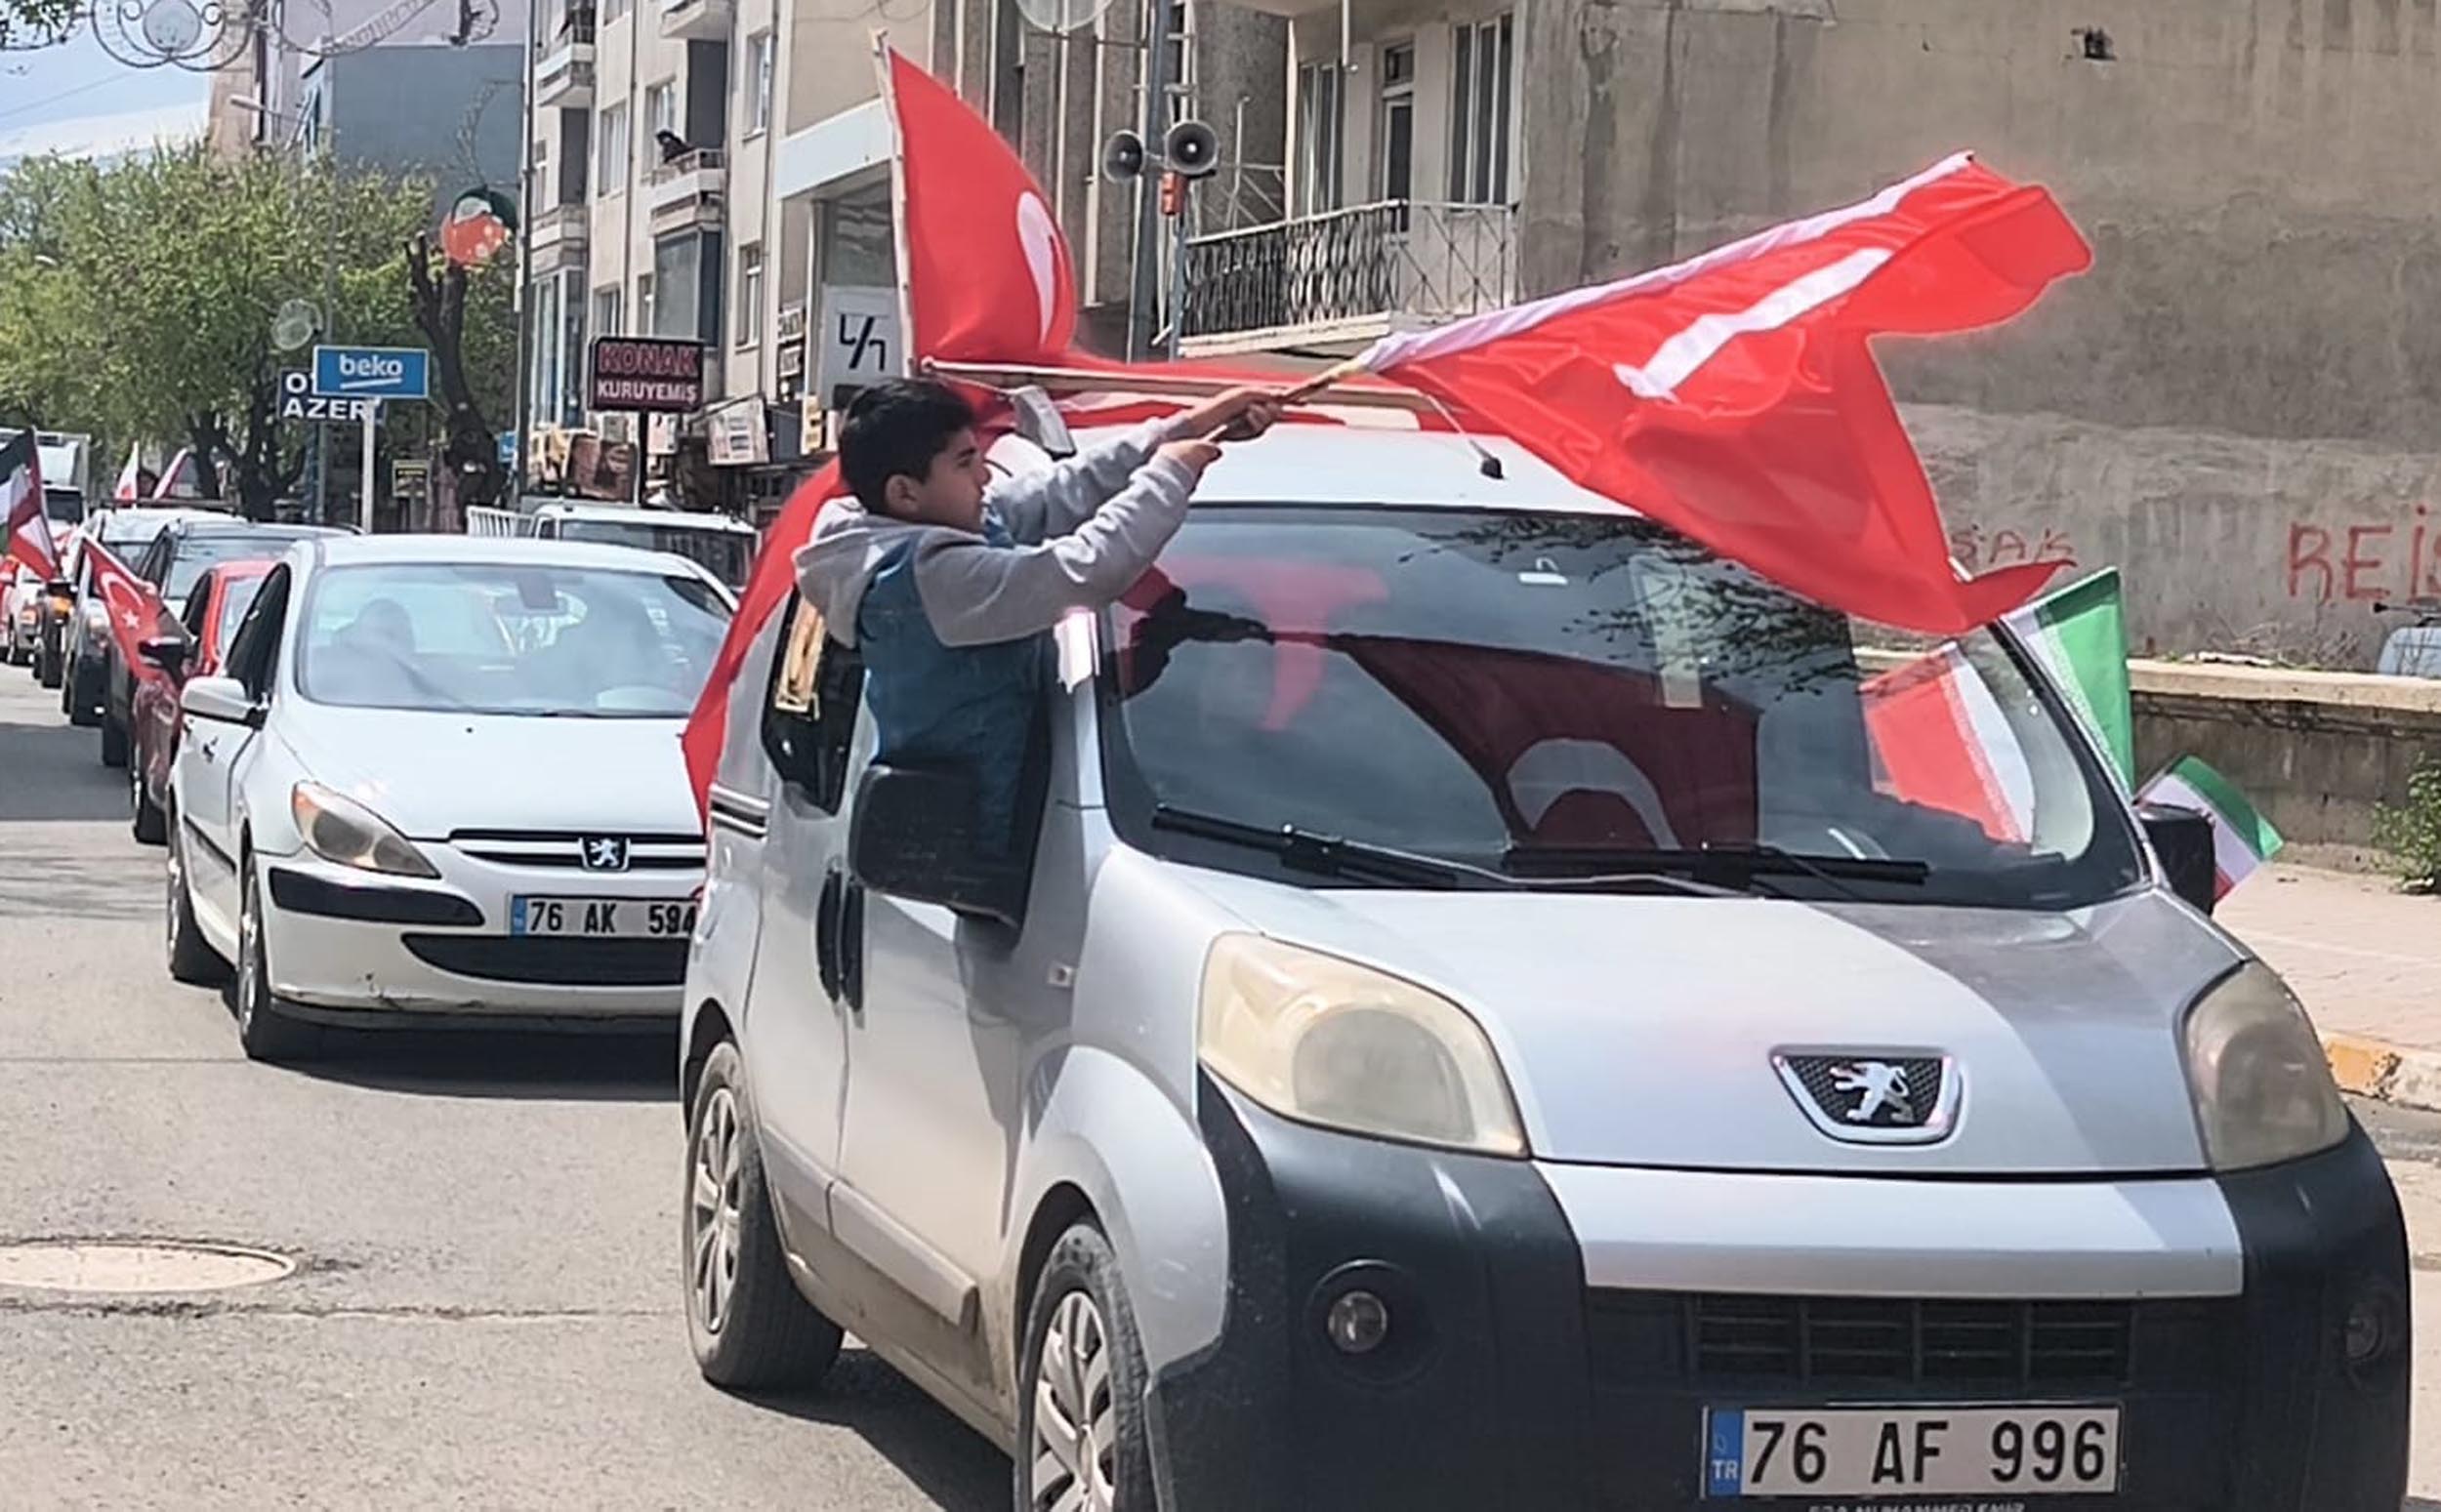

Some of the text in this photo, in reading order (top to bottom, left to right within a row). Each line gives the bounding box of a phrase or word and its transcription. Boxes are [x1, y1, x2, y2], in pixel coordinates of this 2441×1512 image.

[339, 353, 403, 376] beko
[599, 343, 699, 377] KONAK
[530, 902, 563, 931] 76
[584, 903, 617, 933] AK
[1712, 1419, 2106, 1484] TR 76 AF 996
